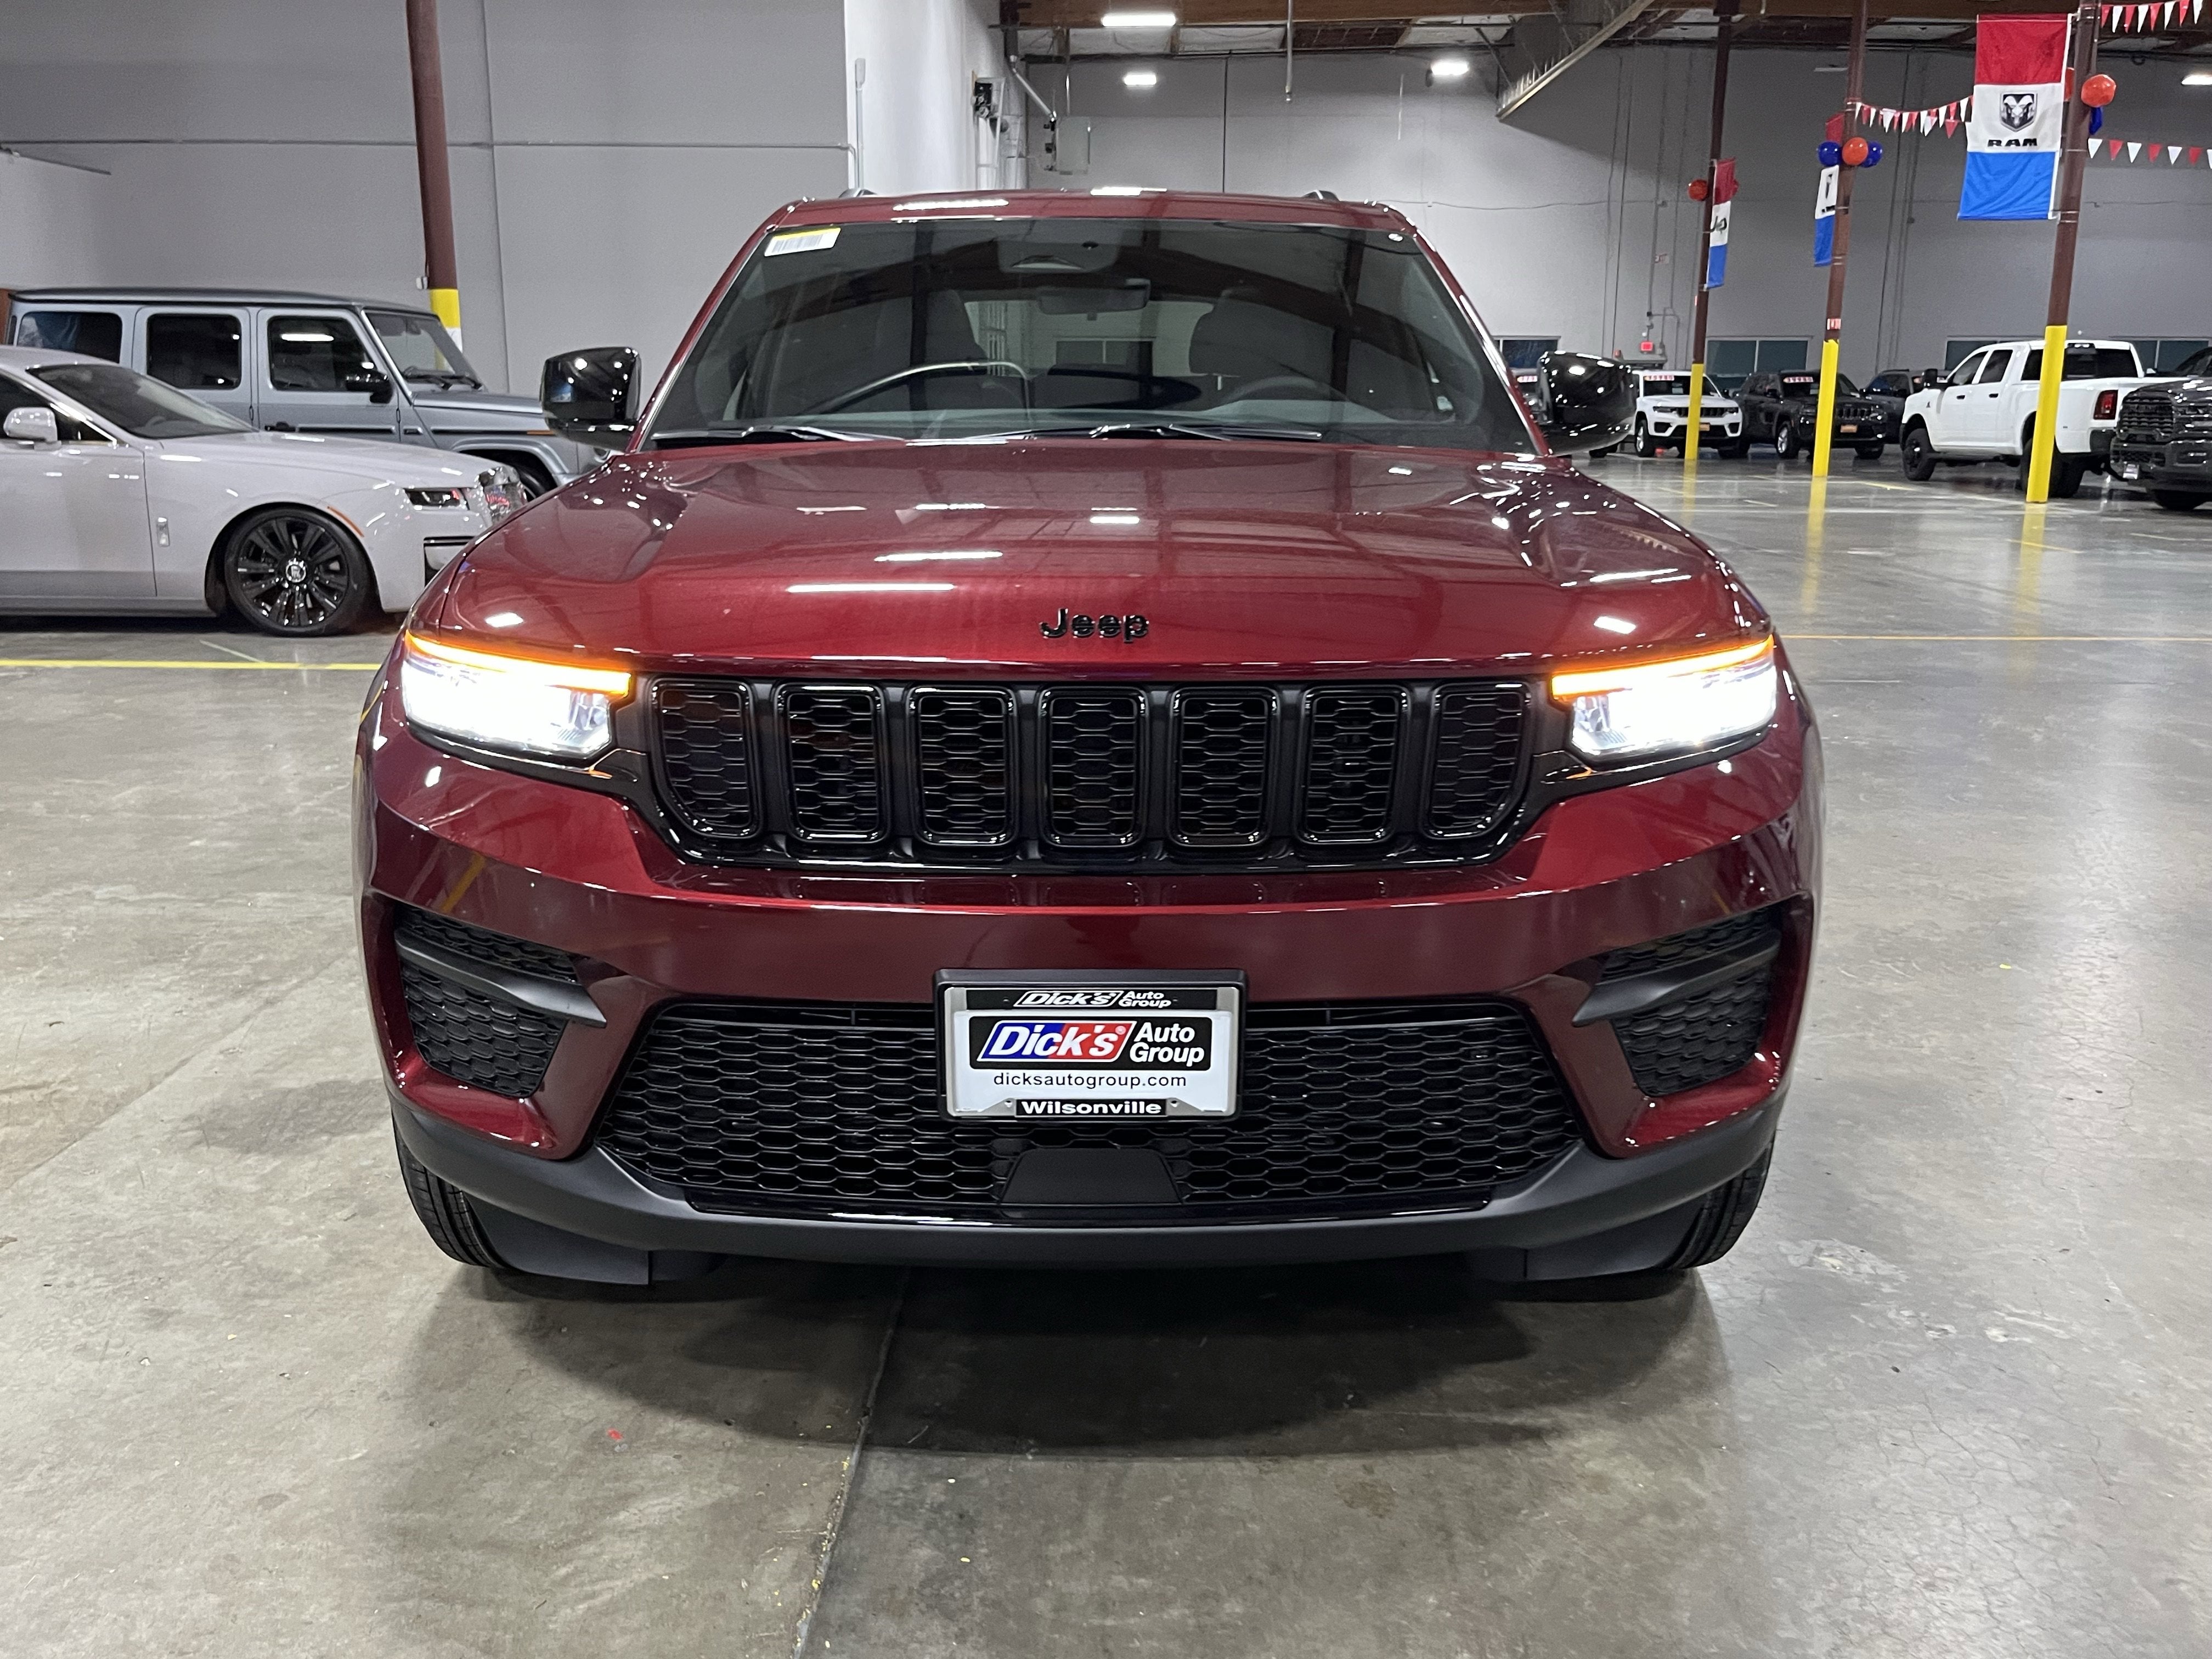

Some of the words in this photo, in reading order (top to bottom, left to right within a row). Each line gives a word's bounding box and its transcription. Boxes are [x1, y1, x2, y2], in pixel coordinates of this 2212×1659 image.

[1988, 138, 2037, 147] RAM
[1039, 608, 1149, 643] Jeep
[1022, 992, 1112, 1006] Dick's
[1118, 998, 1172, 1008] Group
[1122, 991, 1164, 1000] Auto
[1133, 1022, 1195, 1042] Auto
[989, 1024, 1118, 1057] Dick's
[1129, 1043, 1205, 1067] Group
[994, 1073, 1187, 1089] dicksautogroup.com
[1020, 1101, 1162, 1114] Wilsonville
